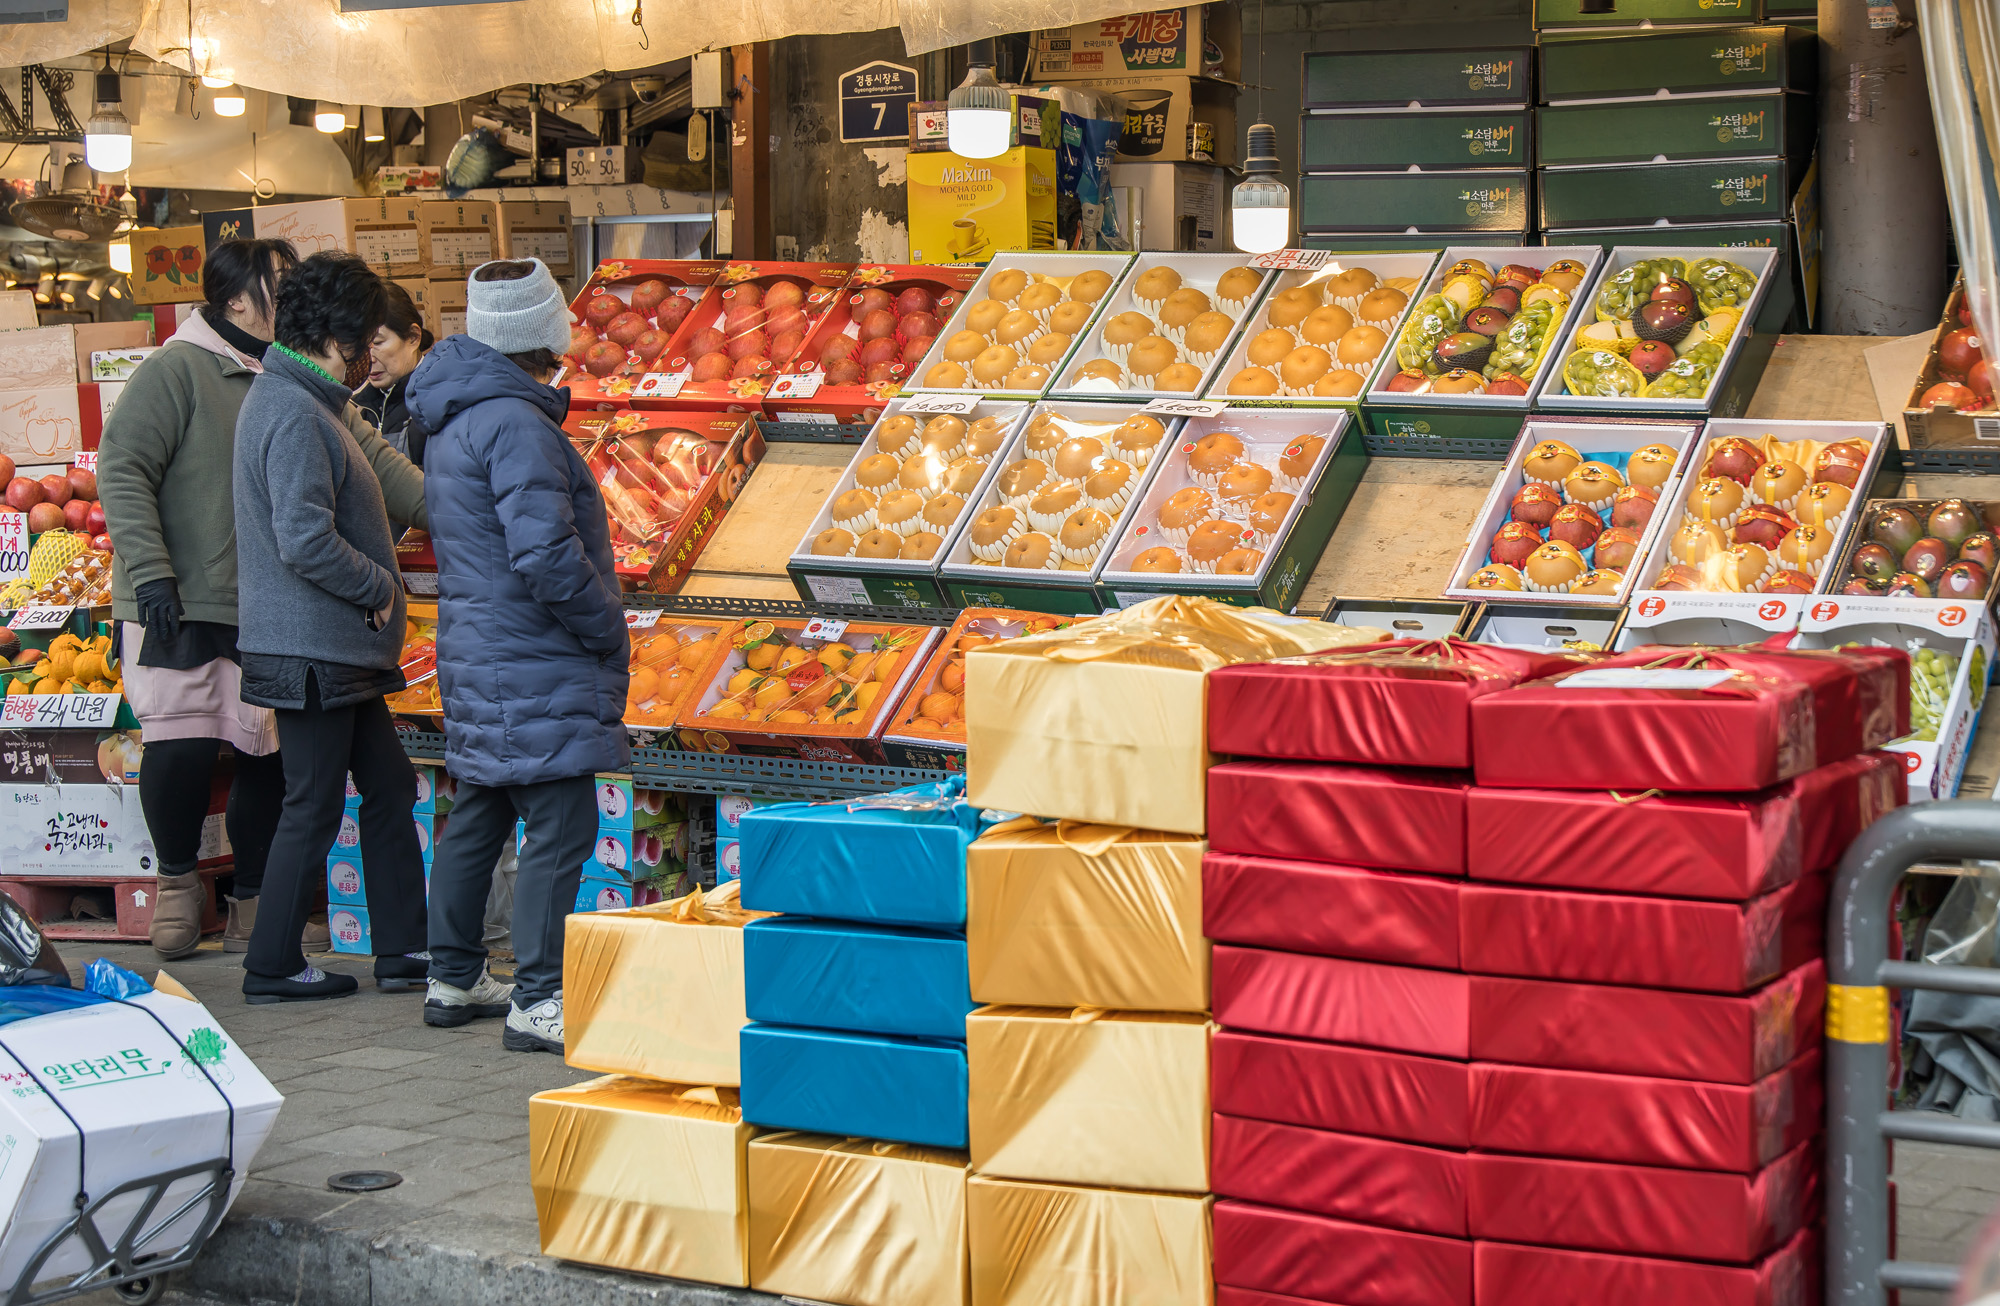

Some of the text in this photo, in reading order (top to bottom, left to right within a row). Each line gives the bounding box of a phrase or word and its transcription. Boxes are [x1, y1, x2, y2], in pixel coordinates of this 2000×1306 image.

[1083, 40, 1114, 48] 한국인의 맛
[1127, 47, 1177, 65] 사발면
[1725, 46, 1744, 58] 소담
[1474, 63, 1492, 74] 소담
[1736, 59, 1751, 67] 마루
[856, 73, 900, 87] 경동시장로
[1484, 75, 1498, 83] 마루
[854, 85, 904, 94] Gyeongdongsijang-ro
[871, 102, 886, 131] 7
[1722, 114, 1742, 126] 소담
[1474, 128, 1492, 140] 소담
[1734, 126, 1748, 134] 마루
[1484, 140, 1498, 148] 마루
[942, 167, 992, 184] Maxim
[1032, 173, 1052, 186] Maxim
[940, 184, 993, 194] MOCHA GOLD
[1725, 177, 1744, 189] 소담
[1470, 190, 1489, 201] 소담
[1736, 190, 1752, 198] 마루
[1482, 202, 1495, 210] 마루
[677, 506, 714, 562] 명품 사과
[4, 694, 108, 727] 한라봉 4개 만원
[800, 744, 843, 760] 한라봉
[906, 751, 938, 763] 레드향
[4, 750, 50, 774] 명품배
[66, 812, 100, 830] 고냉지
[47, 818, 108, 855] 죽령사과
[338, 835, 357, 845] 춘향골
[338, 882, 358, 892] 춘향골
[339, 930, 360, 941] 춘향골
[43, 1048, 152, 1085] 알타리무
